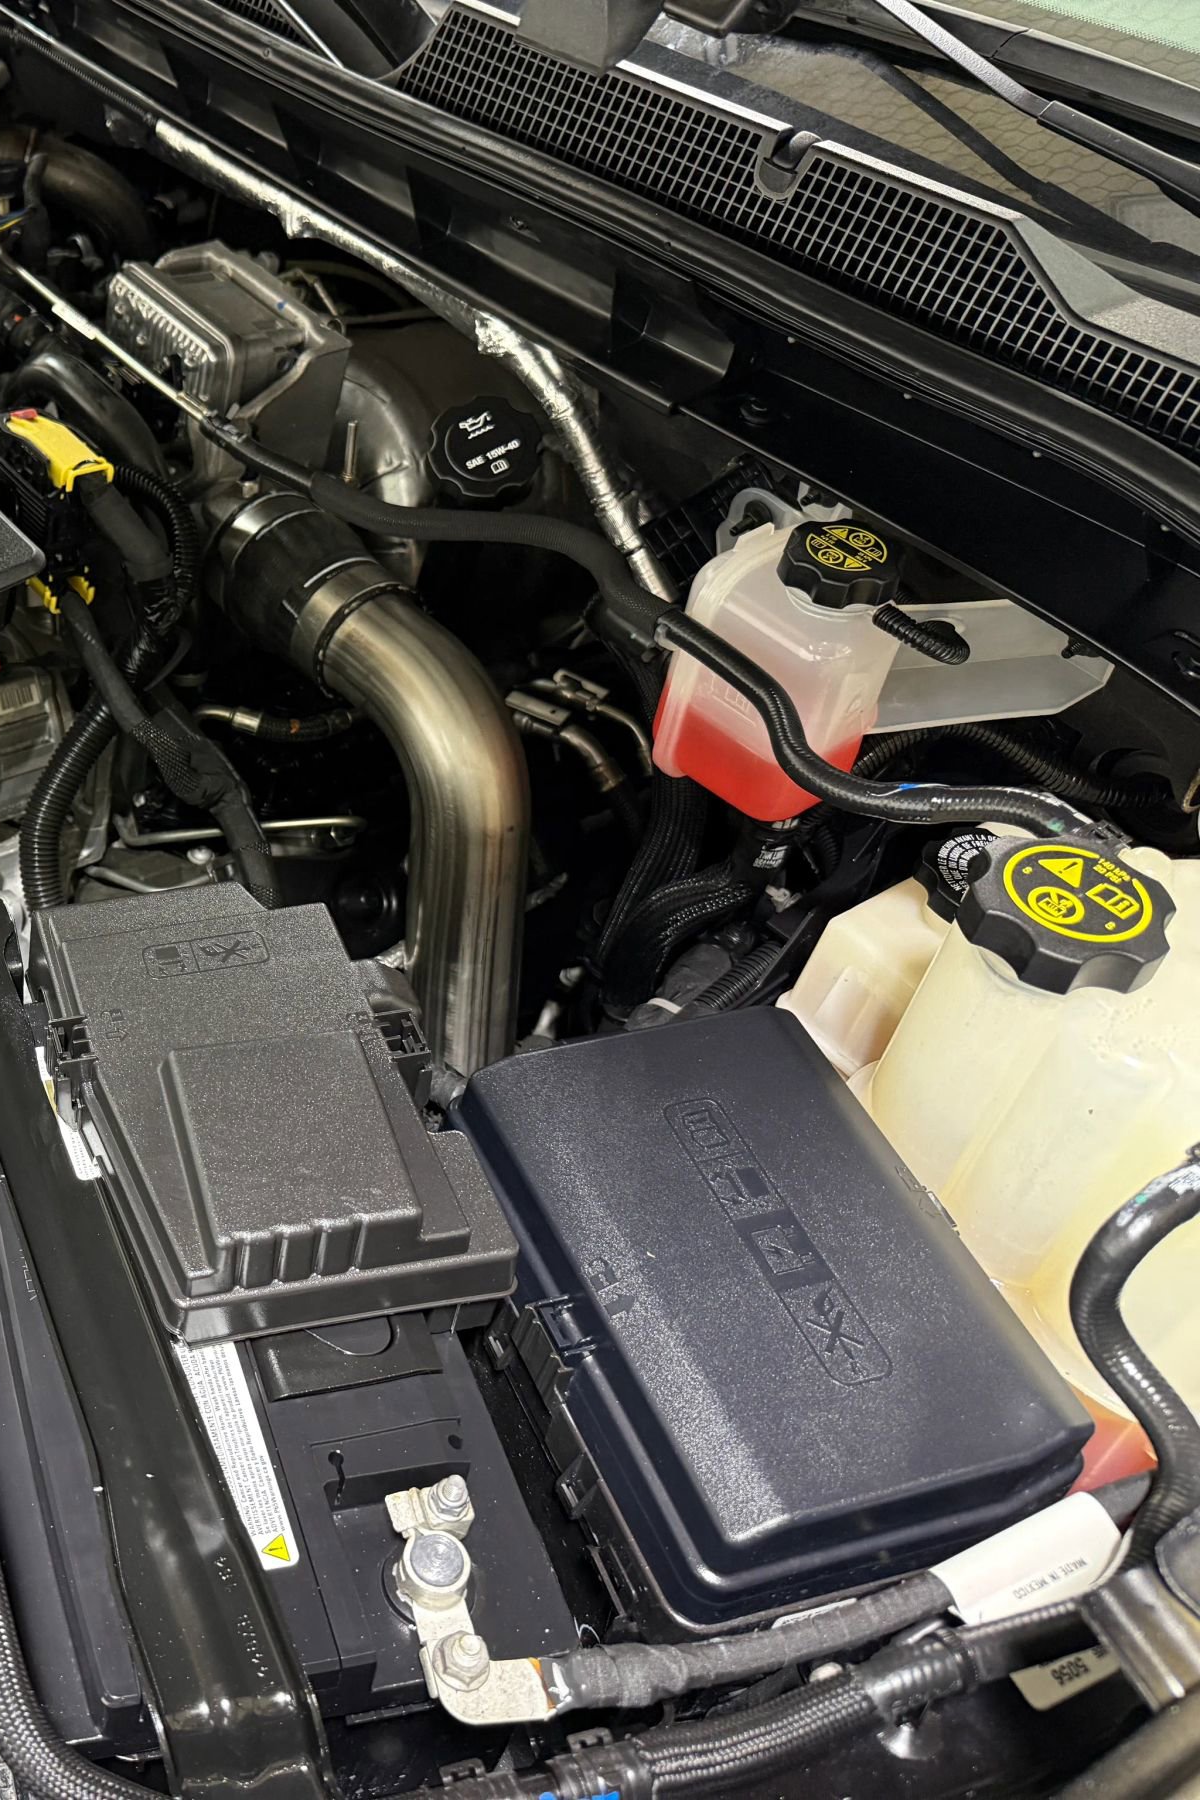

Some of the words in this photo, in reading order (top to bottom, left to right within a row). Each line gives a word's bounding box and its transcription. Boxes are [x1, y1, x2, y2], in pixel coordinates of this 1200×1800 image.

[465, 455, 486, 470] SAE
[485, 439, 521, 460] 15W-40
[1093, 864, 1107, 875] 20
[1104, 871, 1122, 885] PSI
[1098, 858, 1115, 871] 140
[1061, 1557, 1088, 1576] MADE
[1013, 1577, 1049, 1600] MEXICO
